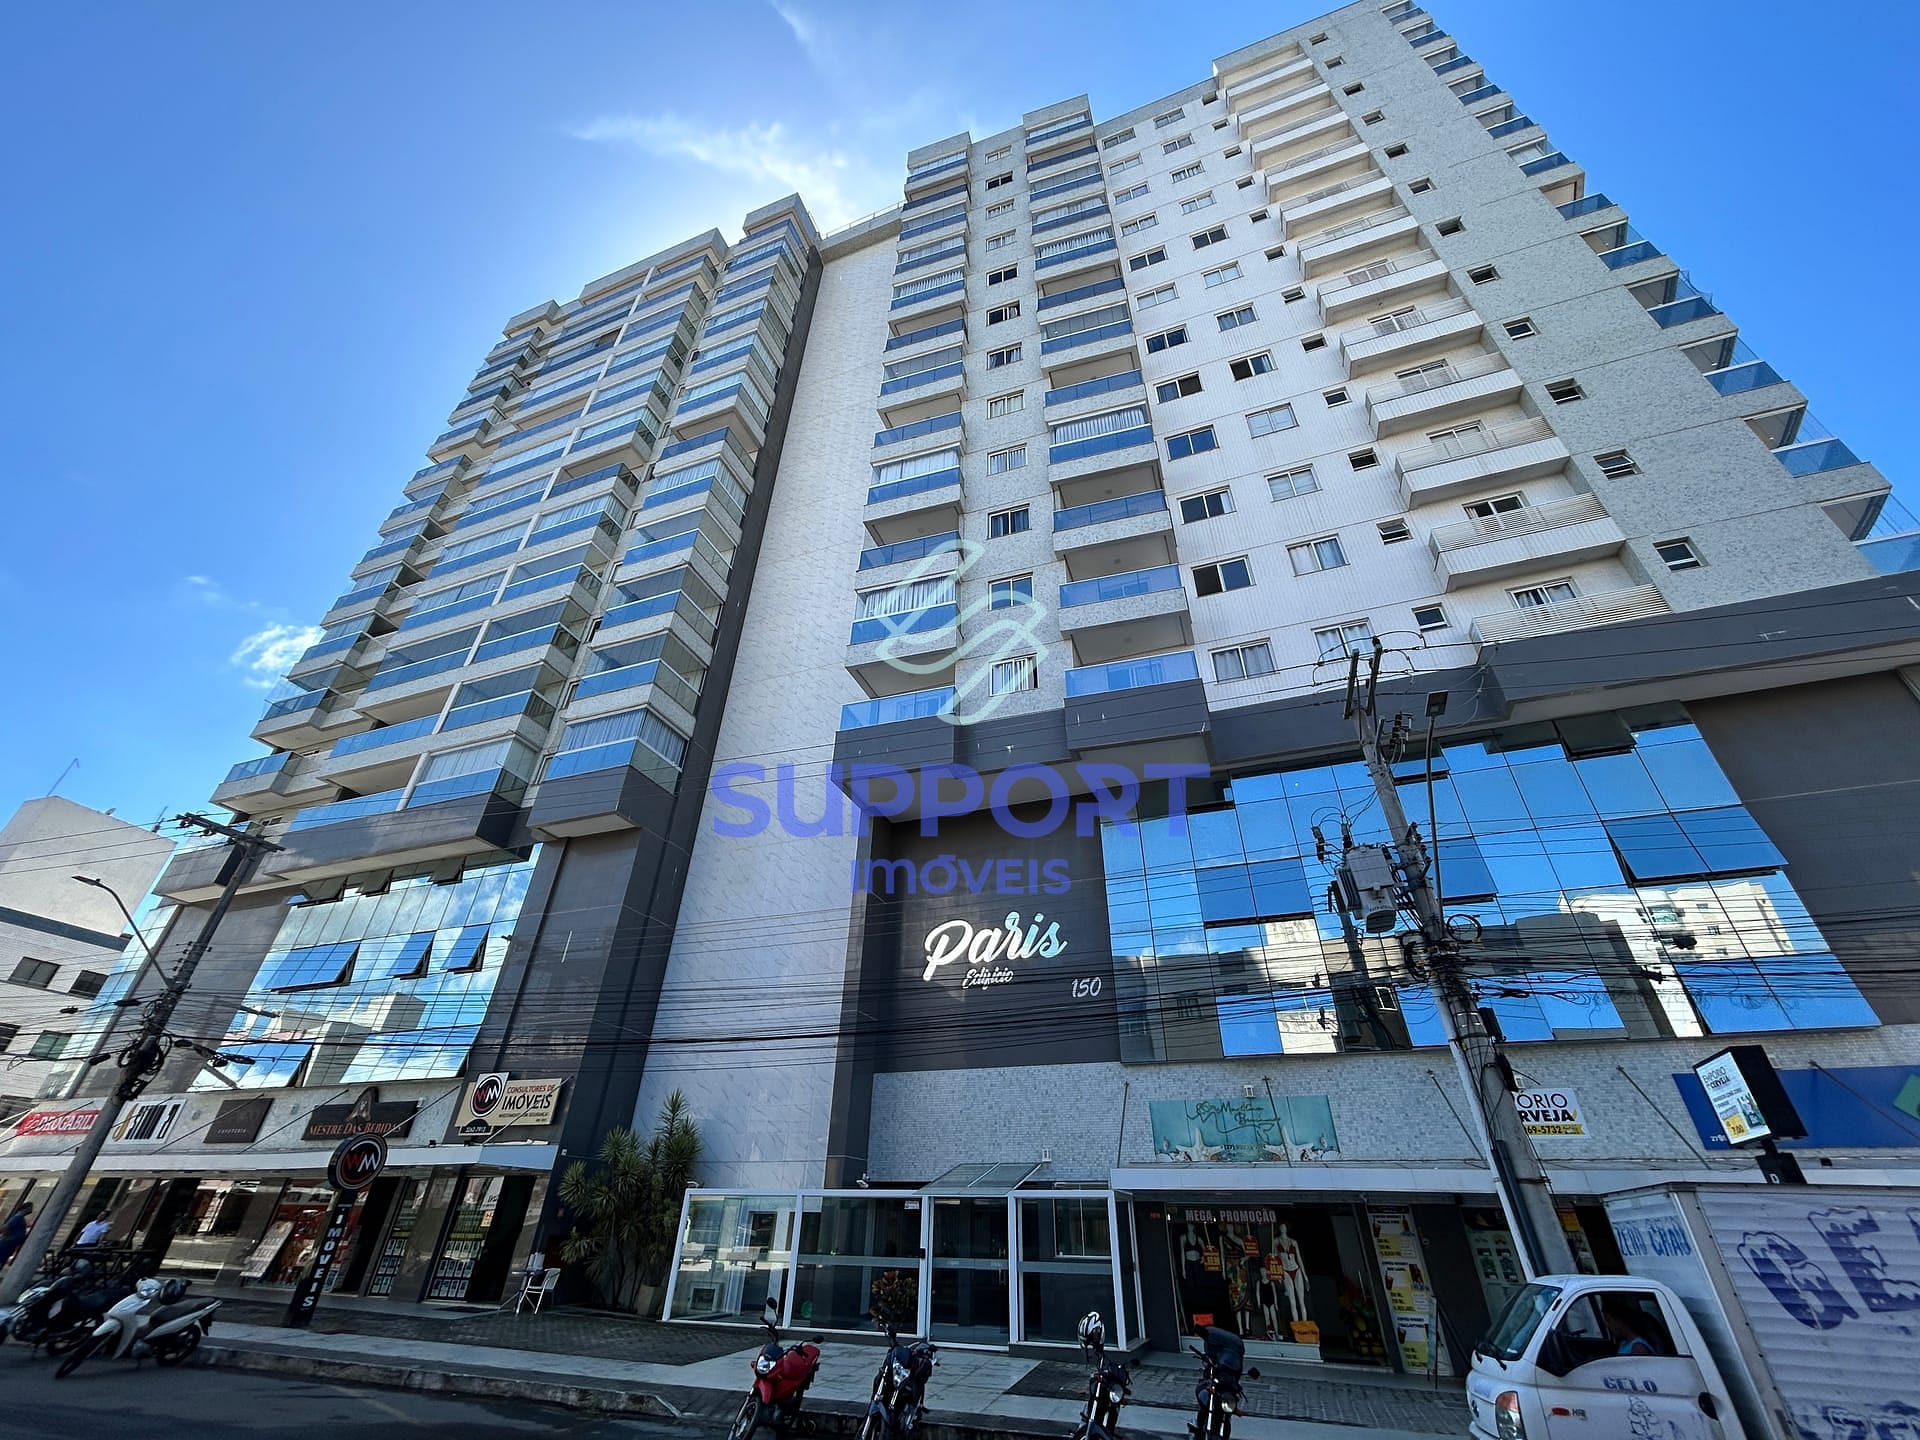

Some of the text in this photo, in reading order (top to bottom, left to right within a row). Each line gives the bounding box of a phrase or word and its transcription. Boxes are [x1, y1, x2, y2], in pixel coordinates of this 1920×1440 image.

[922, 911, 1068, 981] Paris
[1072, 977, 1102, 998] 150
[501, 1093, 553, 1110] IMÓVEIS
[1517, 1109, 1576, 1122] RVEJA
[308, 1123, 344, 1136] MESTRE
[1185, 1208, 1277, 1224] MEGA PROMOÇÃO
[1737, 1206, 1920, 1331] GE
[1603, 1375, 1658, 1393] GELO
